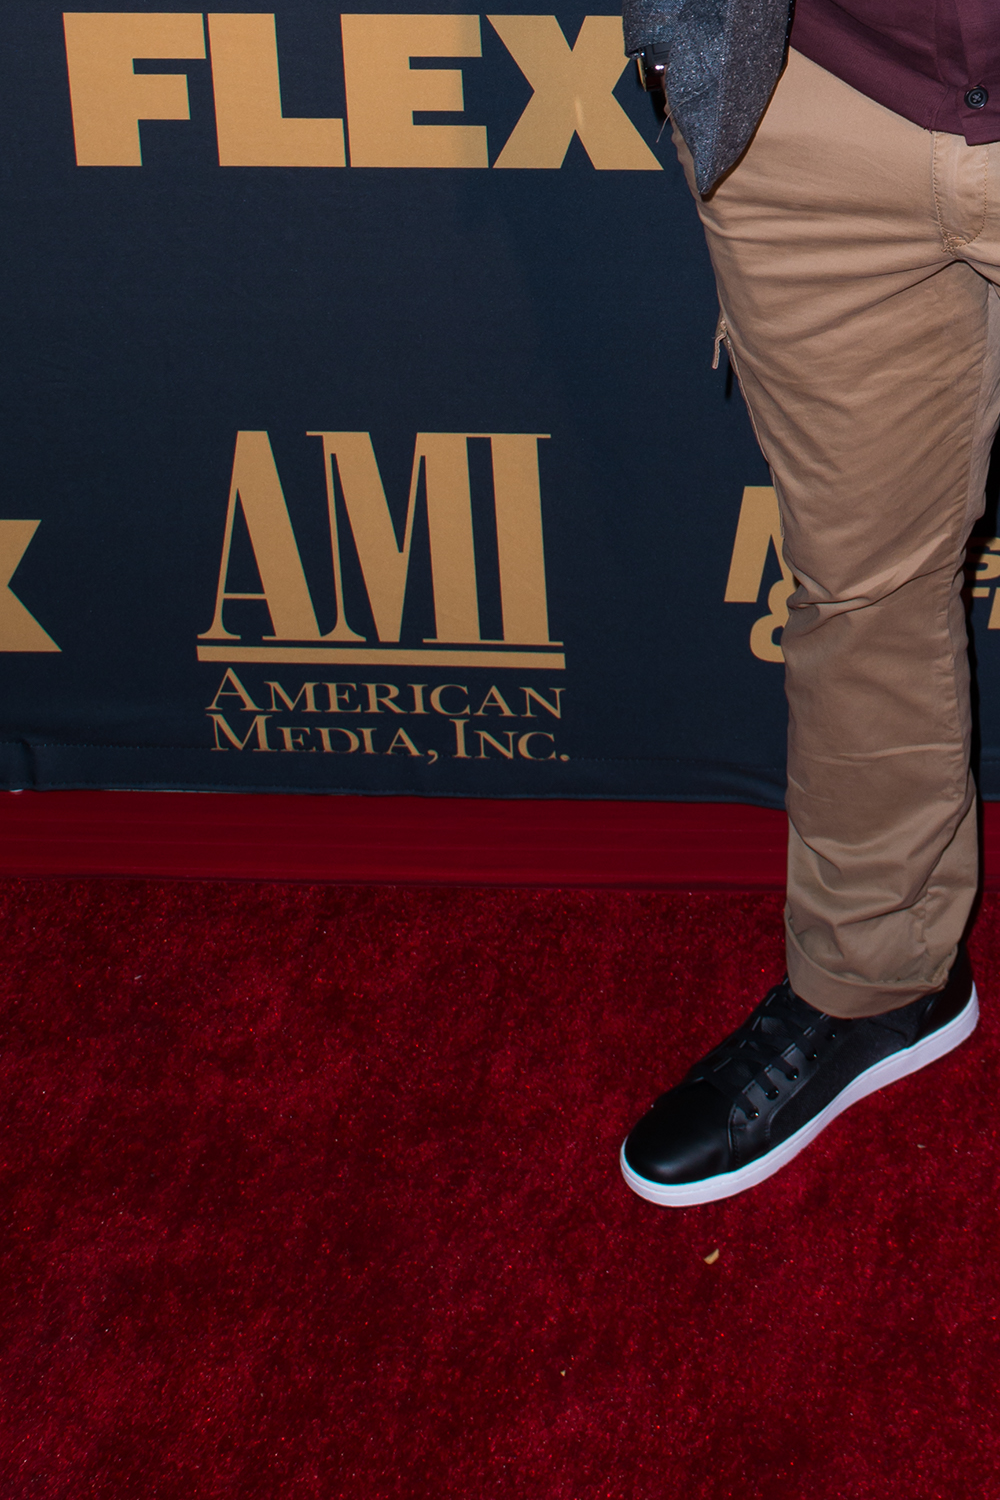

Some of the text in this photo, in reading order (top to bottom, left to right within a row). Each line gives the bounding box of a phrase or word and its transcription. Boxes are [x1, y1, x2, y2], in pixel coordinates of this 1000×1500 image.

[63, 12, 664, 170] FLEX
[197, 430, 564, 646] AMI
[205, 667, 566, 719] AMERICAN
[449, 718, 571, 762] INC.
